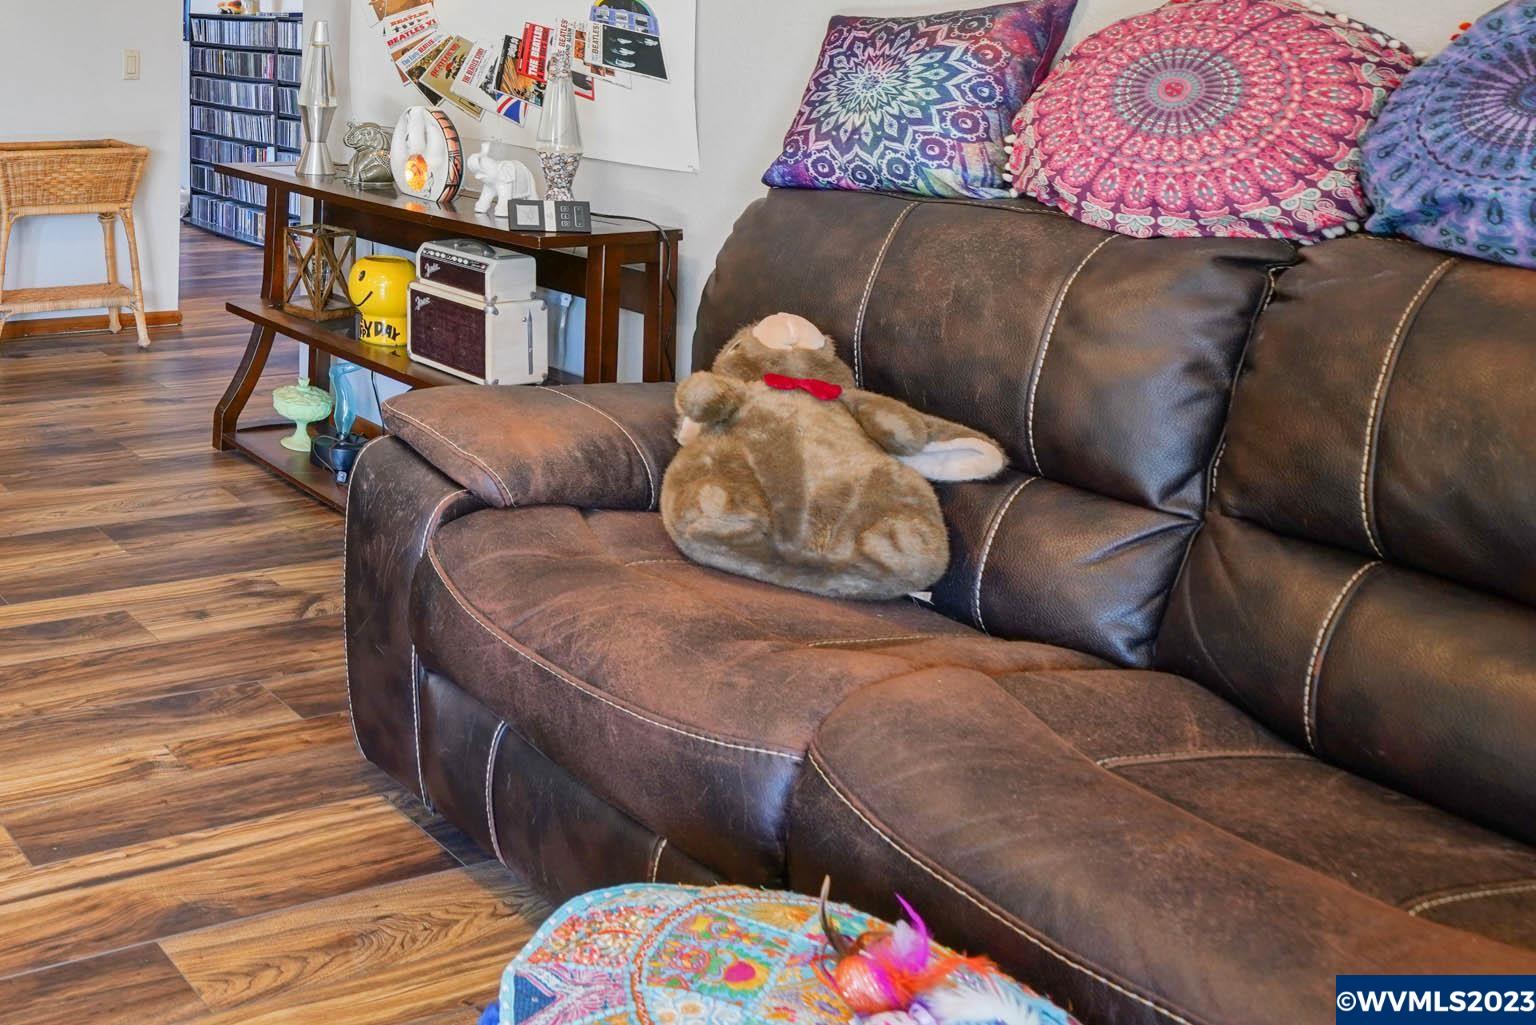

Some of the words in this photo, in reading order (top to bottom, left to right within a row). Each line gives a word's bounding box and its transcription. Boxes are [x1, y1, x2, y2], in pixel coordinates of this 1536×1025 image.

[531, 26, 544, 57] BEATLES
[528, 56, 540, 76] THE
[374, 321, 400, 341] DAY
